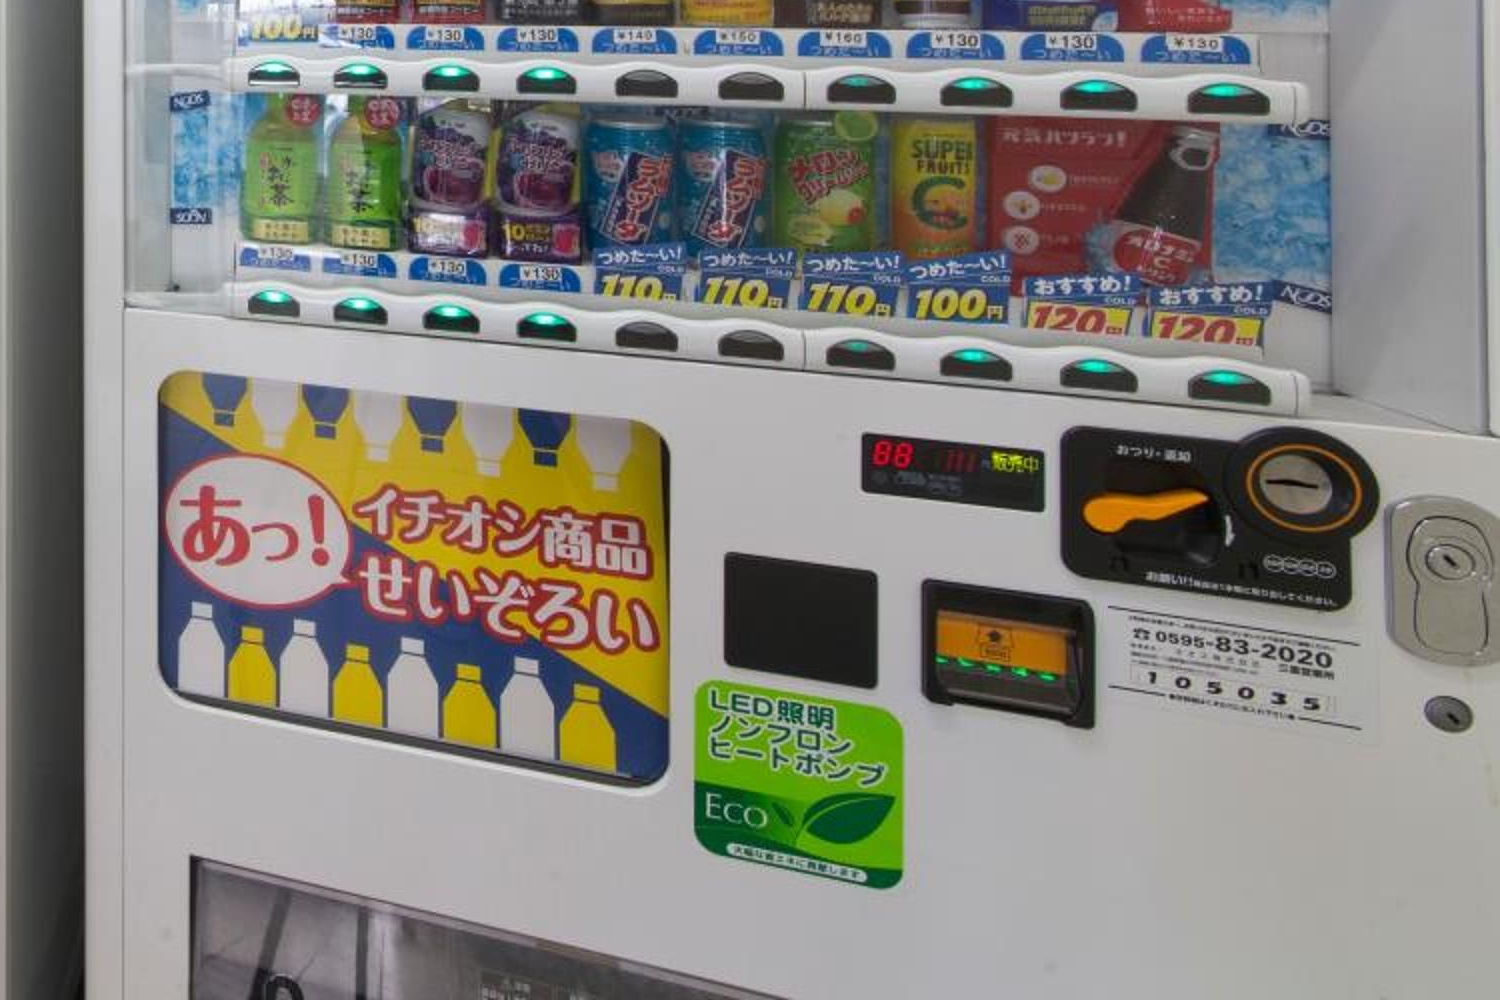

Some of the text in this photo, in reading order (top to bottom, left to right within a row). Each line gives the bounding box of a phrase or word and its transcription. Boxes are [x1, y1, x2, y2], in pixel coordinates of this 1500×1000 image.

[935, 34, 979, 47] ¥130
[1049, 36, 1094, 49] ¥130
[1173, 38, 1219, 50] ¥130
[1034, 276, 1132, 295] おすすめ!
[1159, 285, 1263, 306] おすすめ!
[179, 484, 331, 567] あっ!
[355, 485, 653, 580] イチオシ商品
[358, 553, 660, 655] せいぞろい
[1155, 630, 1333, 669] 0595-83-2020
[709, 688, 836, 732] LED照明
[709, 714, 853, 755] ノンフロン
[709, 736, 886, 787] ヒートポンプ
